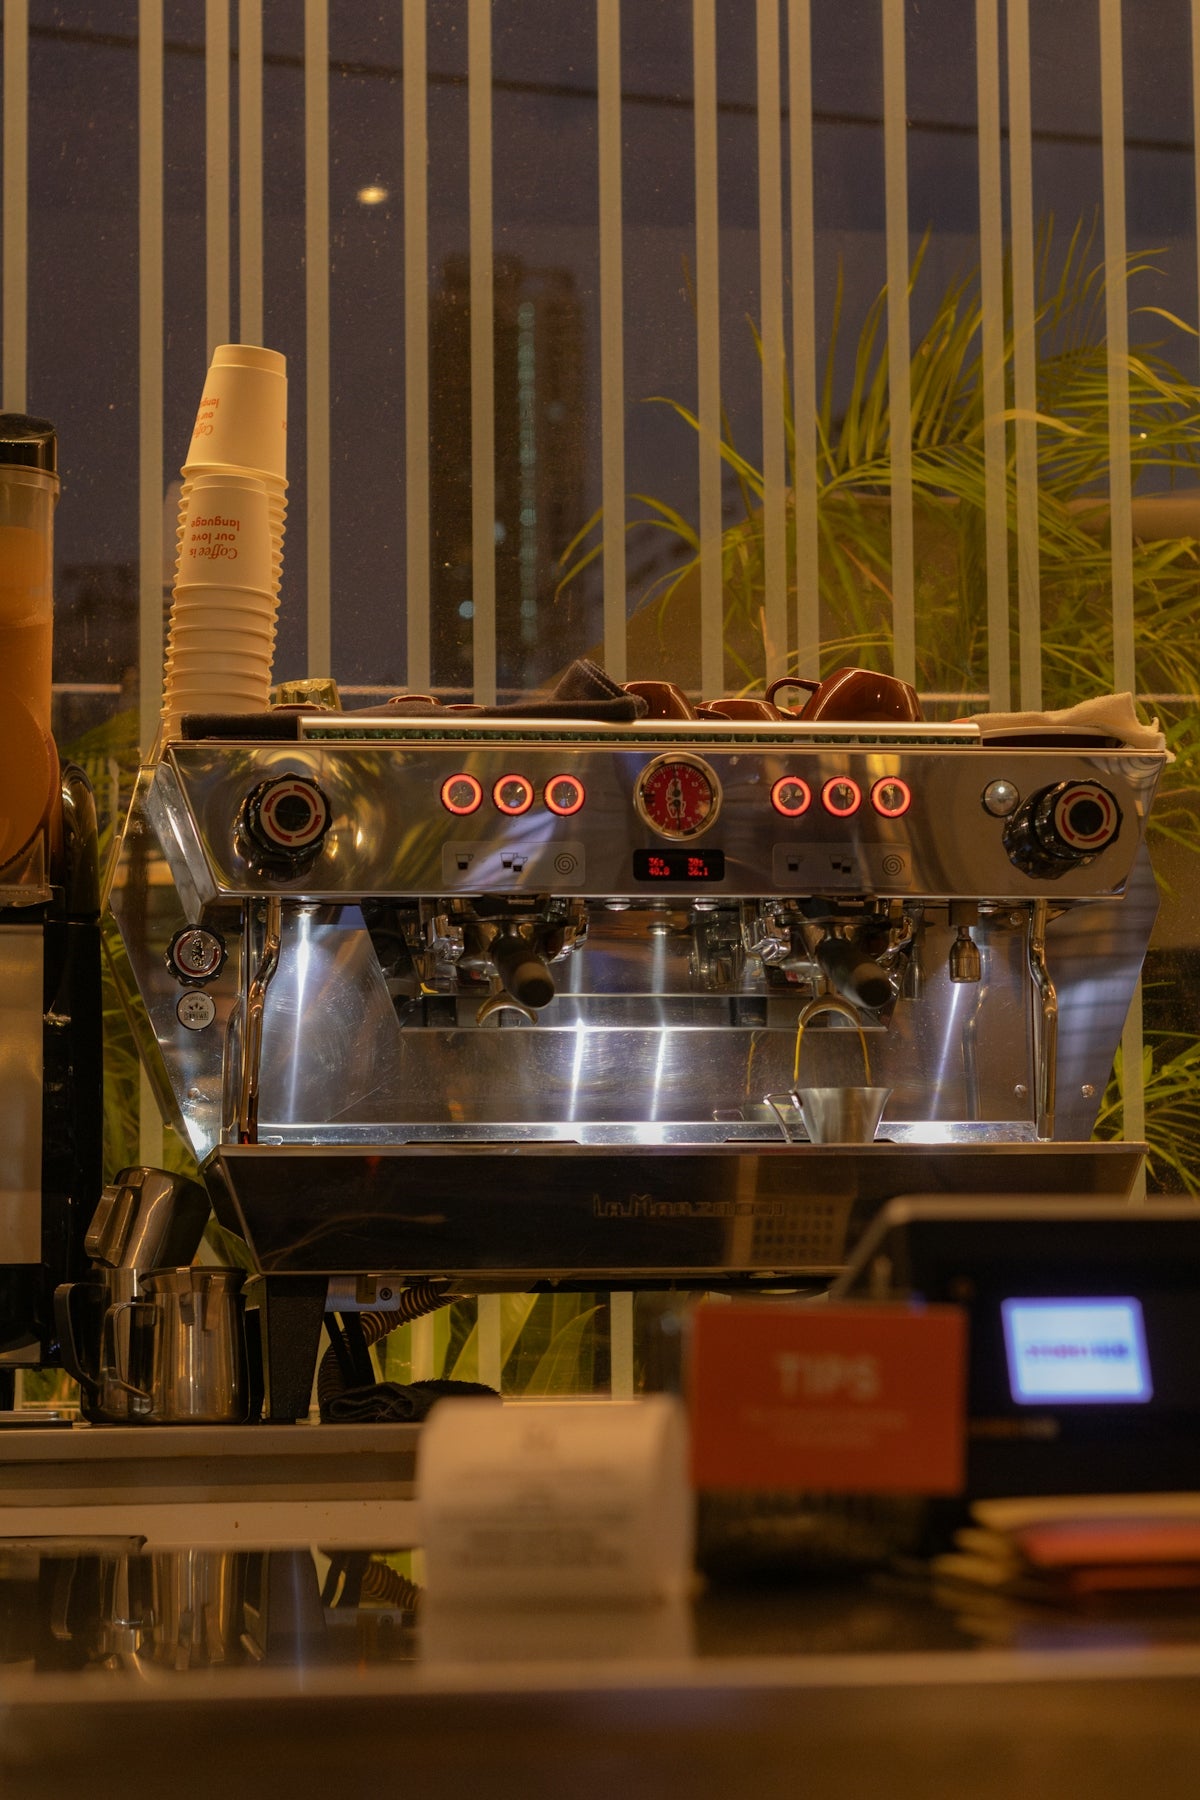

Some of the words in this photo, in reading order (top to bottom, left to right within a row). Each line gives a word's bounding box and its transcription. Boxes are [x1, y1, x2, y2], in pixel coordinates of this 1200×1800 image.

[191, 516, 240, 531] language
[191, 533, 212, 544] love
[215, 533, 236, 541] our
[190, 548, 197, 558] is
[198, 544, 238, 560] Coffee
[774, 1348, 882, 1401] TIPS
